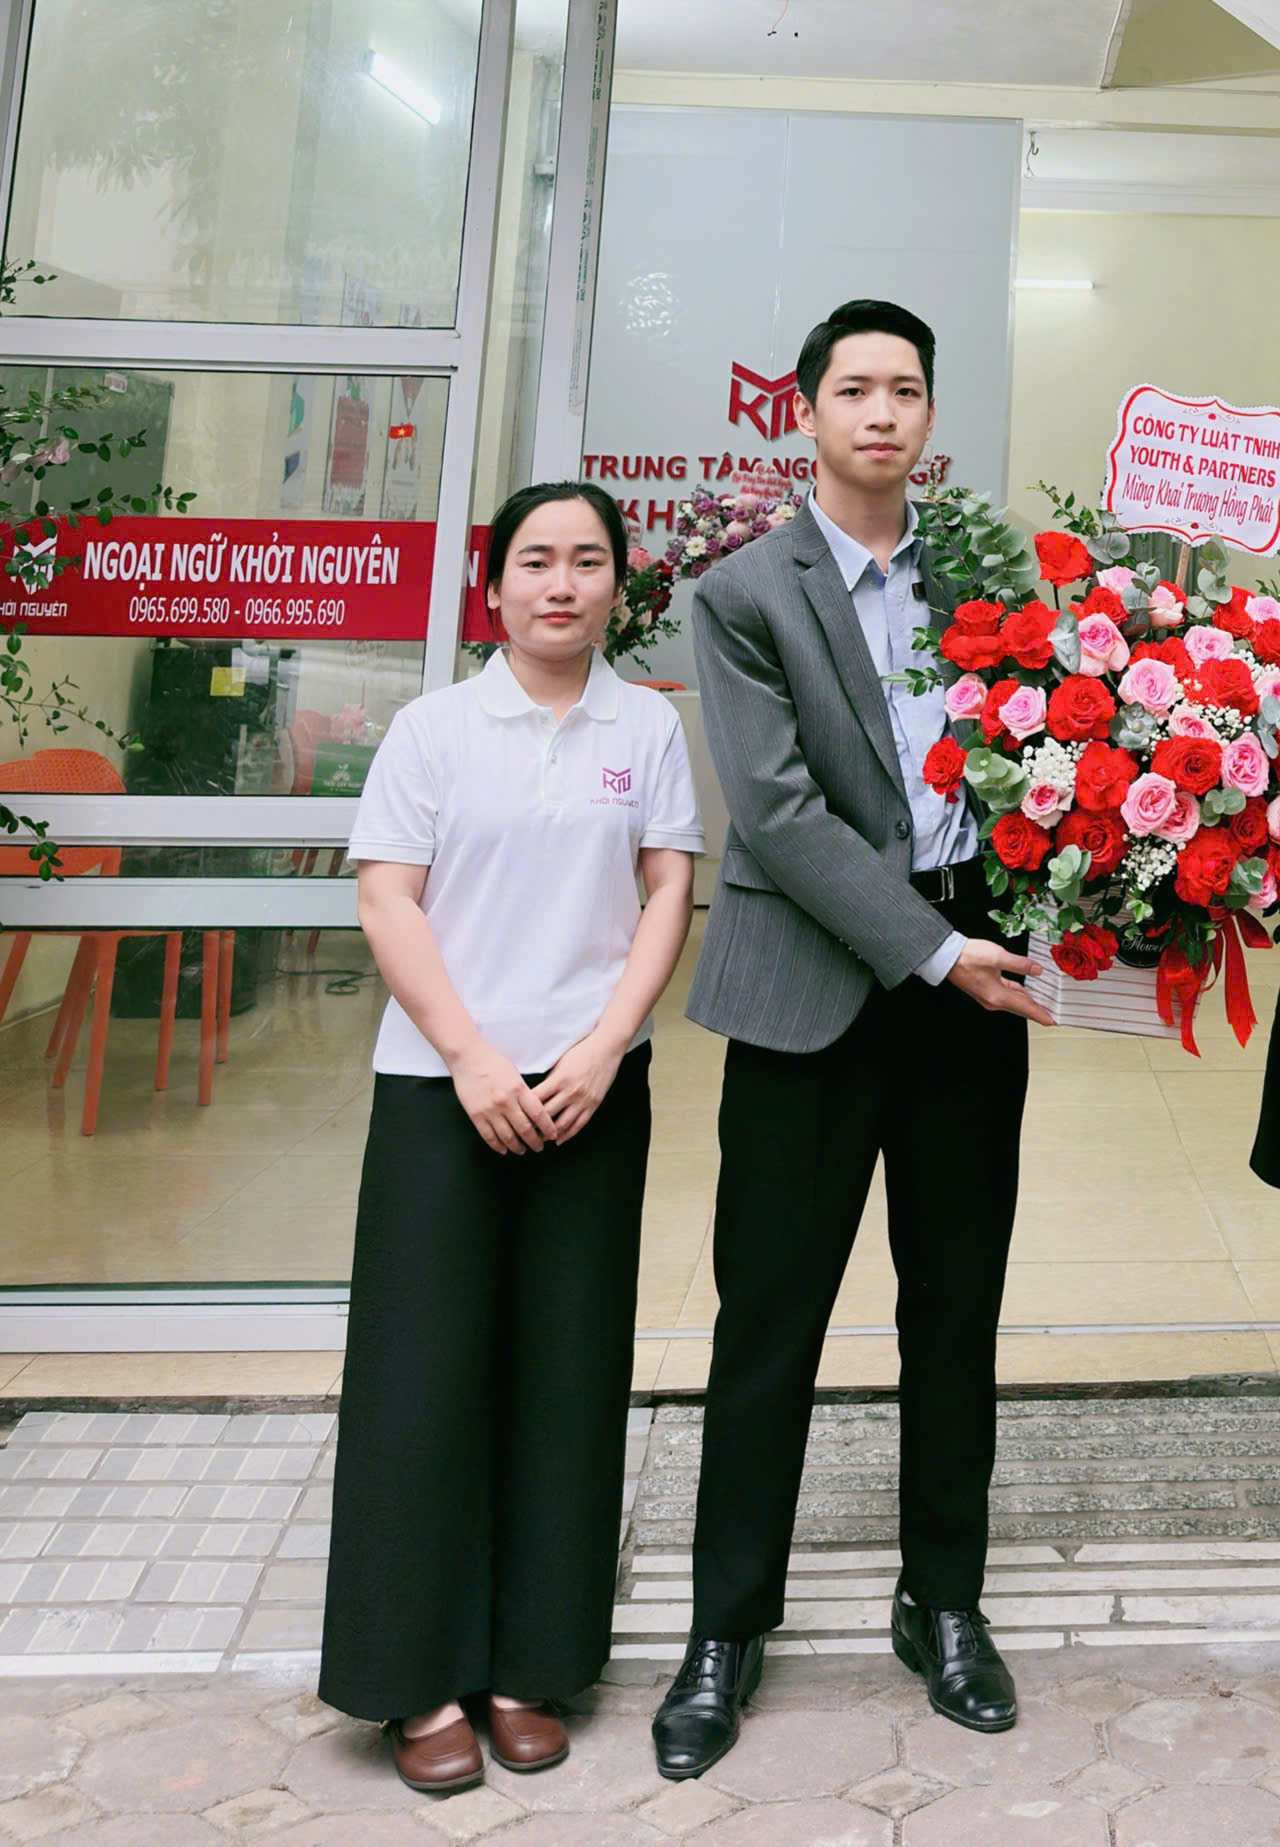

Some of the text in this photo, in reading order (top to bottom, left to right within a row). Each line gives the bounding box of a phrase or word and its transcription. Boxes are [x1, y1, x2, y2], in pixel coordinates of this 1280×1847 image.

[1133, 413, 1175, 440] CÔNG
[1178, 424, 1199, 443] TY
[1244, 435, 1280, 459] TNHH
[583, 455, 687, 479] TRUNG
[1130, 445, 1276, 488] YOUTH & PARTNERS
[1156, 478, 1184, 507] Khai
[1219, 485, 1248, 525] Hồng
[1249, 494, 1274, 523] Phát
[83, 531, 399, 590] NGOẠI NGỮ KHỞI NGUYÊN
[129, 597, 229, 623] 0965.699.580
[245, 598, 345, 625] 0966.995.690
